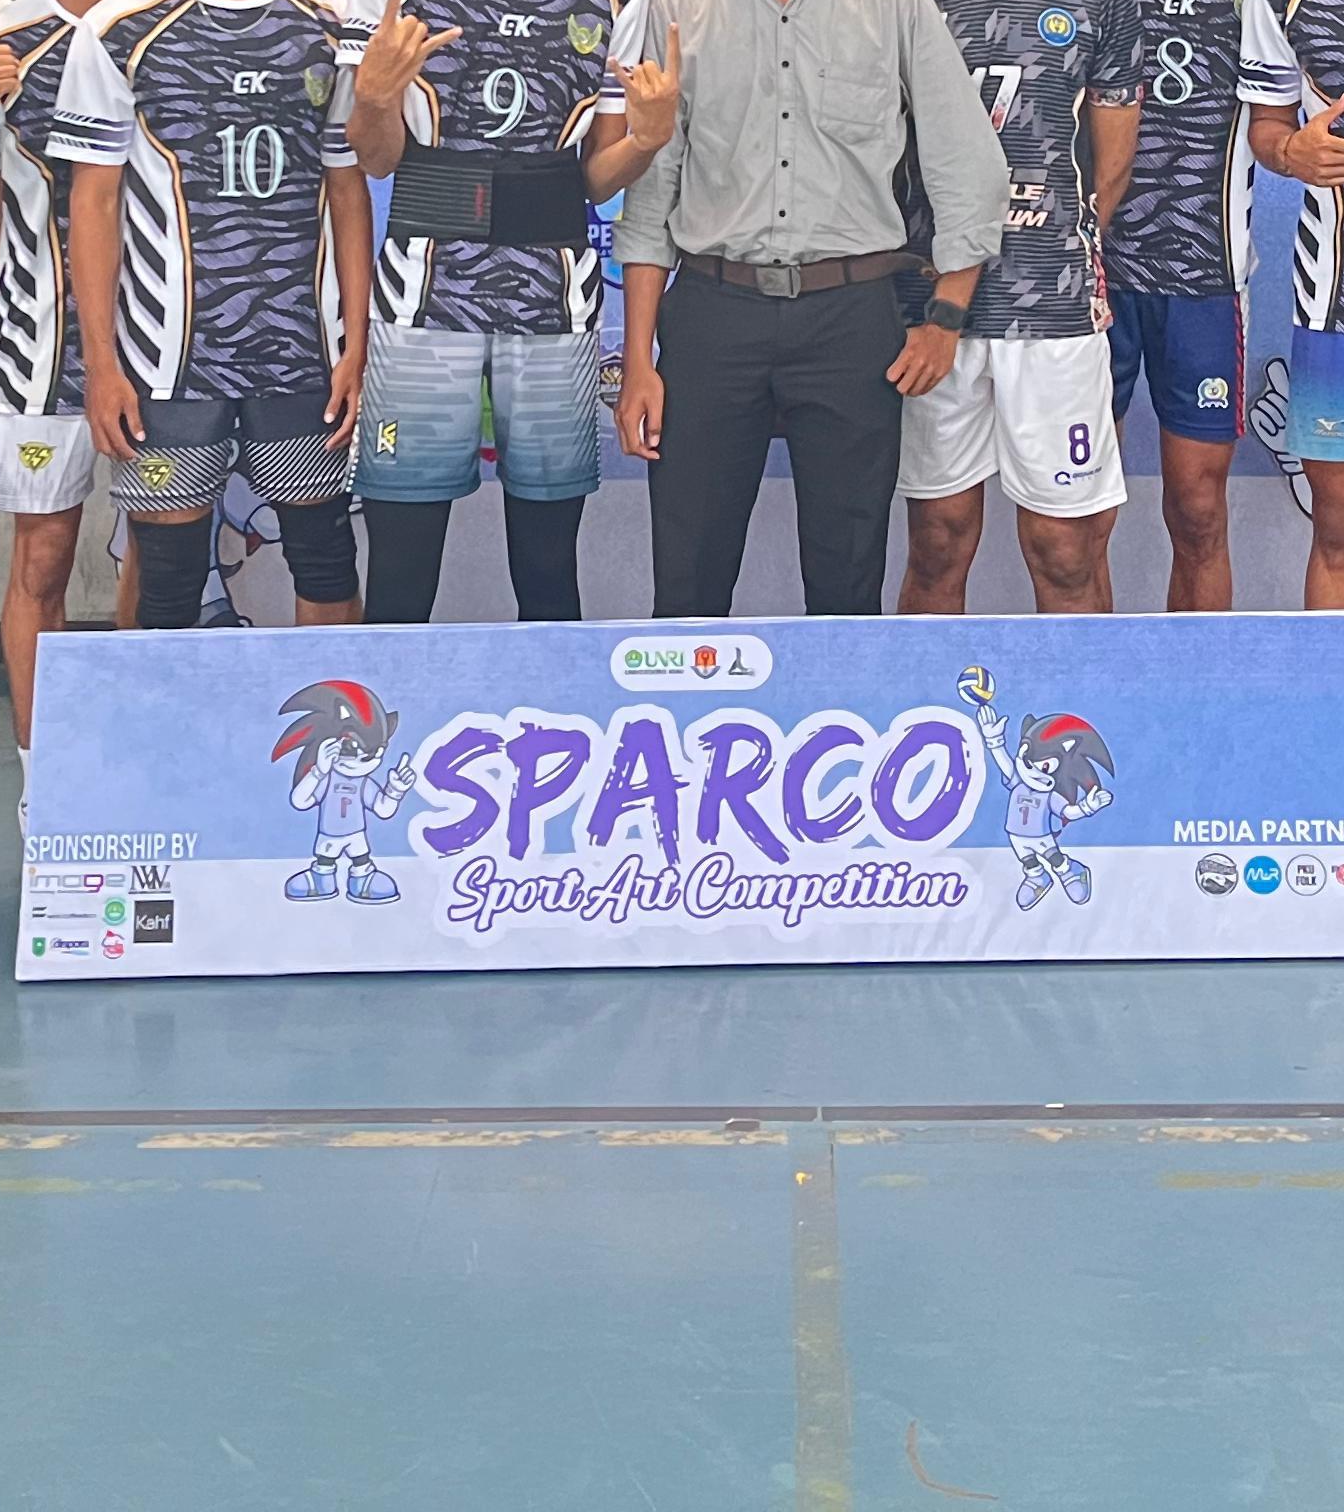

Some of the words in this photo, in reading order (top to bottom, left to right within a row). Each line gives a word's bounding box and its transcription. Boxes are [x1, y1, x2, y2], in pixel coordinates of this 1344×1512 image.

[1153, 37, 1193, 104] 8
[483, 68, 528, 139] 9
[216, 124, 285, 199] 10
[1068, 423, 1090, 465] 8
[644, 650, 684, 667] UNRI
[423, 719, 971, 865] SPARCO
[25, 834, 166, 861] SPONSORSHIP
[171, 833, 198, 859] BY
[1173, 820, 1256, 843] MEDIA
[447, 855, 586, 932] Sport
[580, 854, 682, 924] Art
[683, 852, 968, 928] Competition
[135, 914, 172, 931] Kahf
